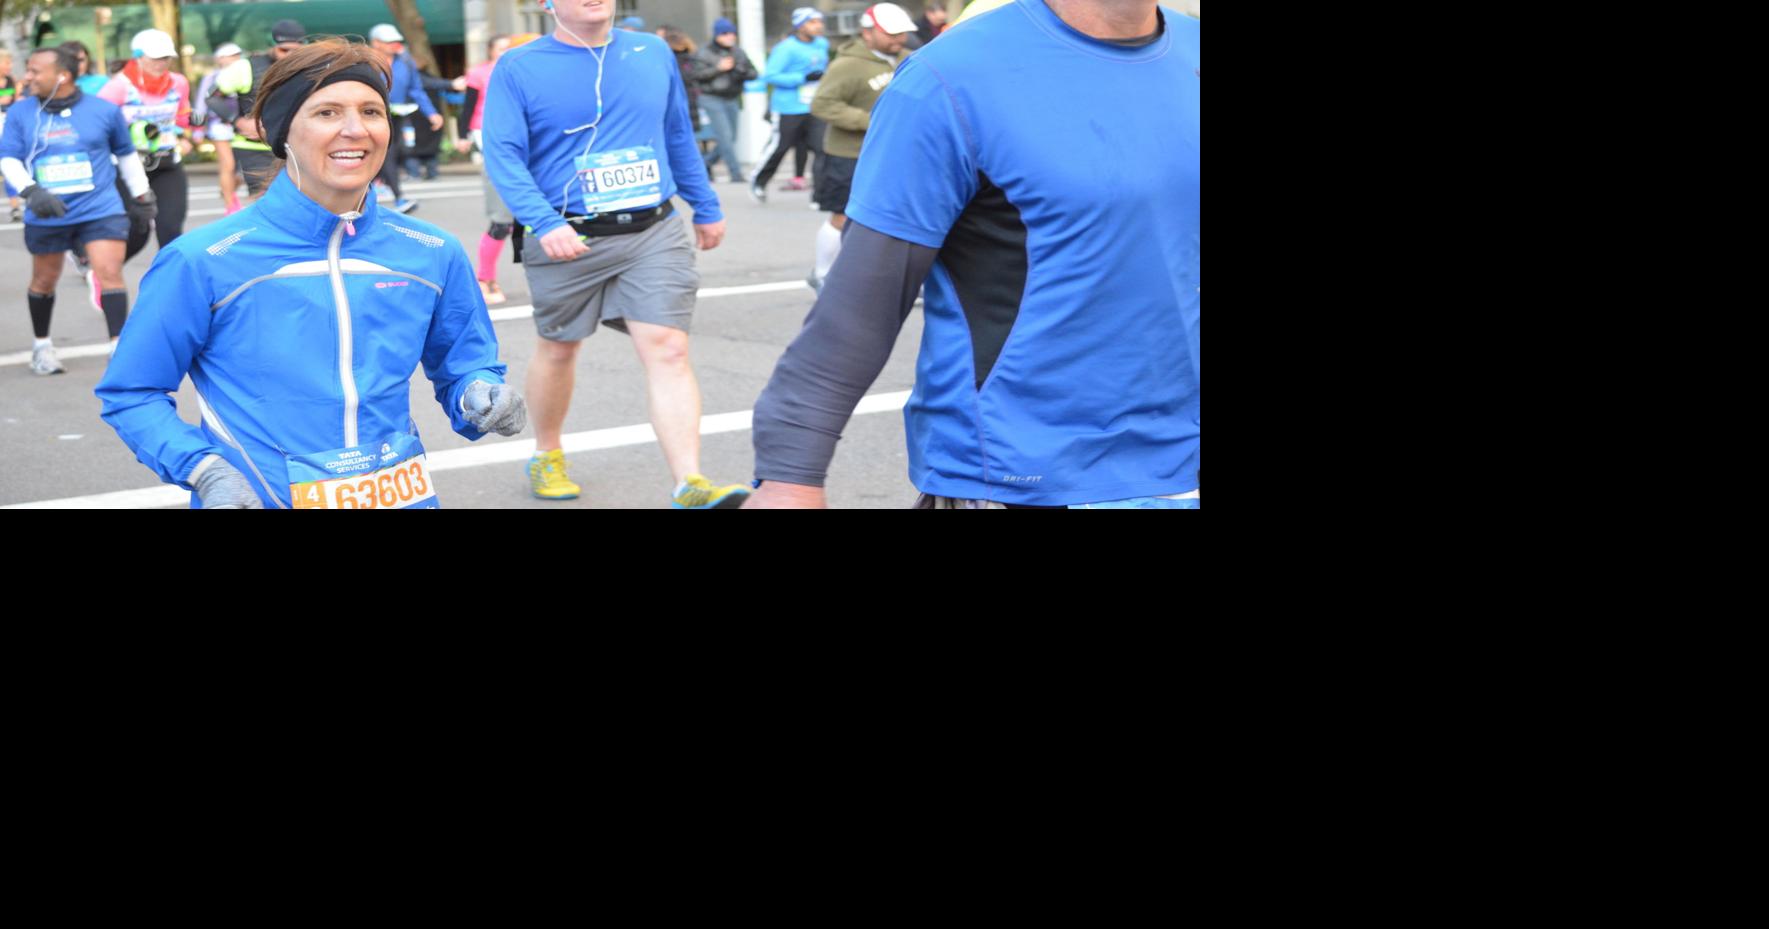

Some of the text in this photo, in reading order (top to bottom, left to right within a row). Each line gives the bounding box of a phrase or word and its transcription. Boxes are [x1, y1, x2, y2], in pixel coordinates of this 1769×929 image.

[602, 164, 654, 187] 60374
[325, 454, 377, 469] CONSULTANCY
[338, 450, 362, 460] TATA
[336, 463, 371, 474] SERVICES
[307, 462, 428, 509] 4 63603
